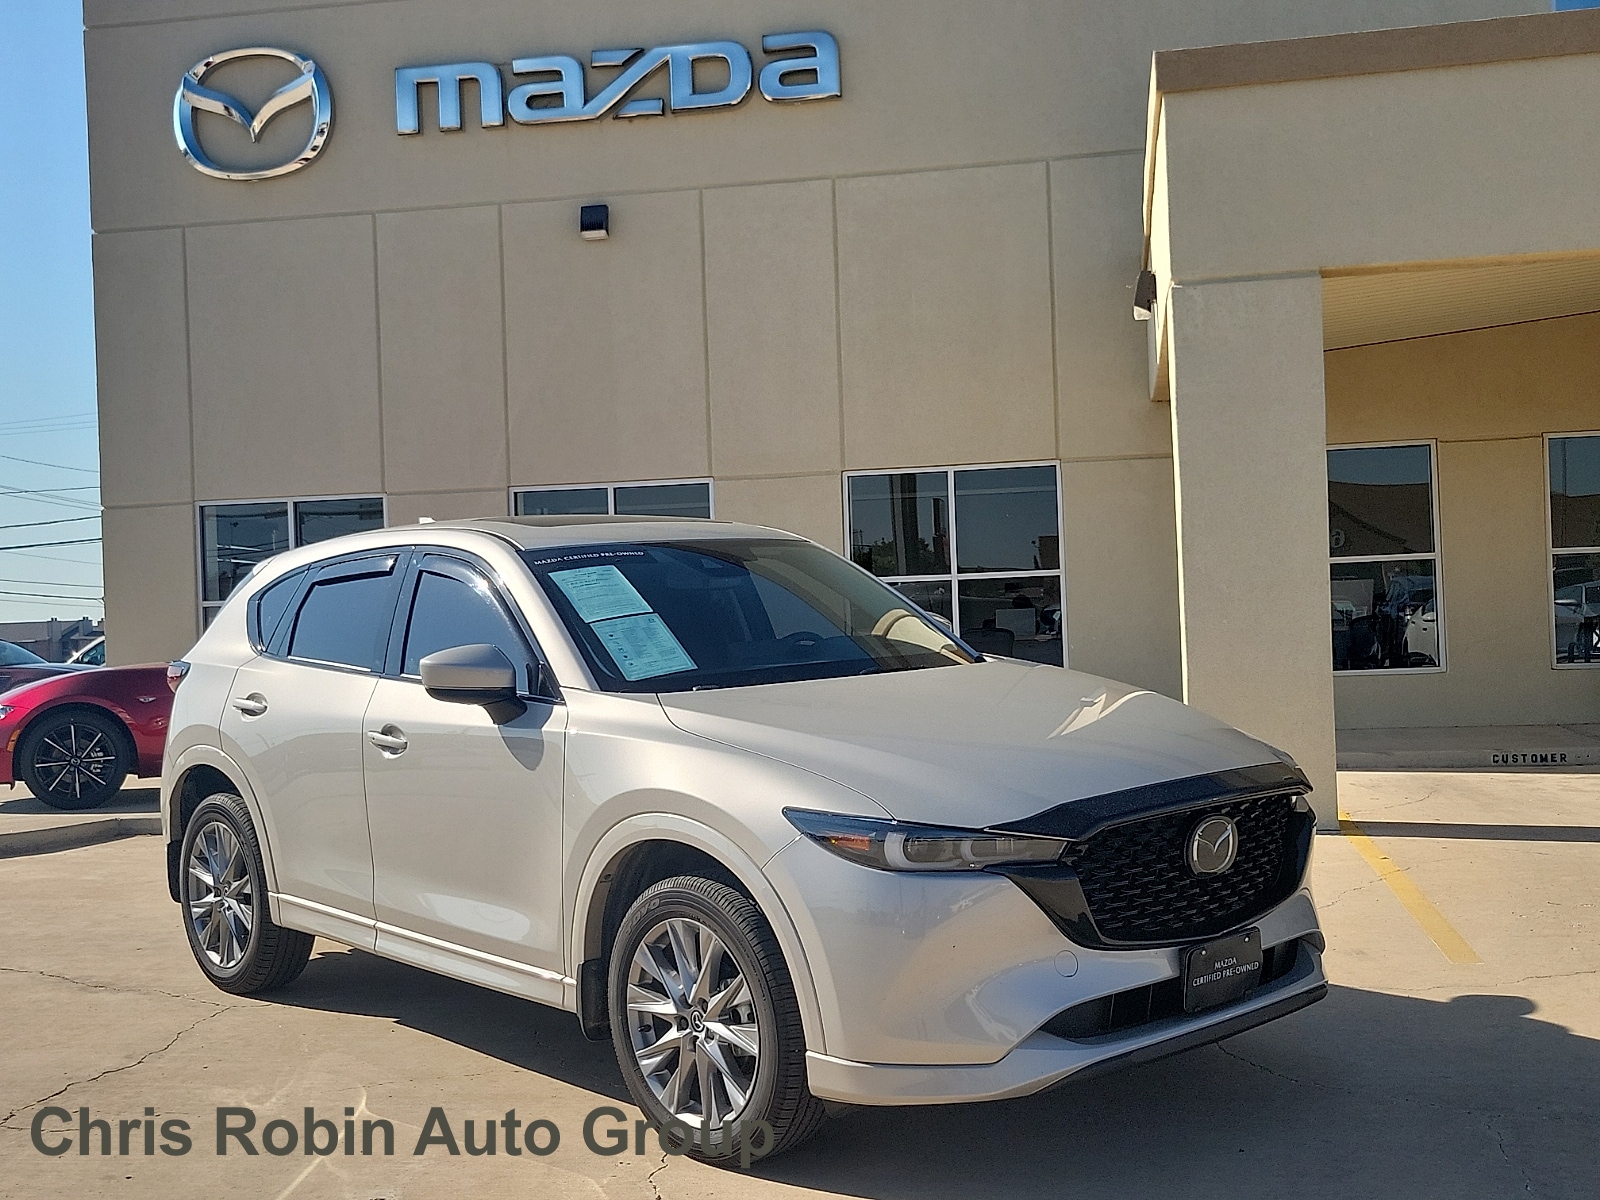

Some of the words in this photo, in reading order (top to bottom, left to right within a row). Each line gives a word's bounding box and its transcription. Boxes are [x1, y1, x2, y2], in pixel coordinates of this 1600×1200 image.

[534, 557, 563, 565] MAZDA
[564, 553, 599, 561] CERTIFIED
[1492, 753, 1567, 764] CUSTOMER
[1214, 957, 1237, 970] MAZDA
[1192, 971, 1221, 987] CERTIFIED
[1222, 961, 1259, 978] PRE-OWNED
